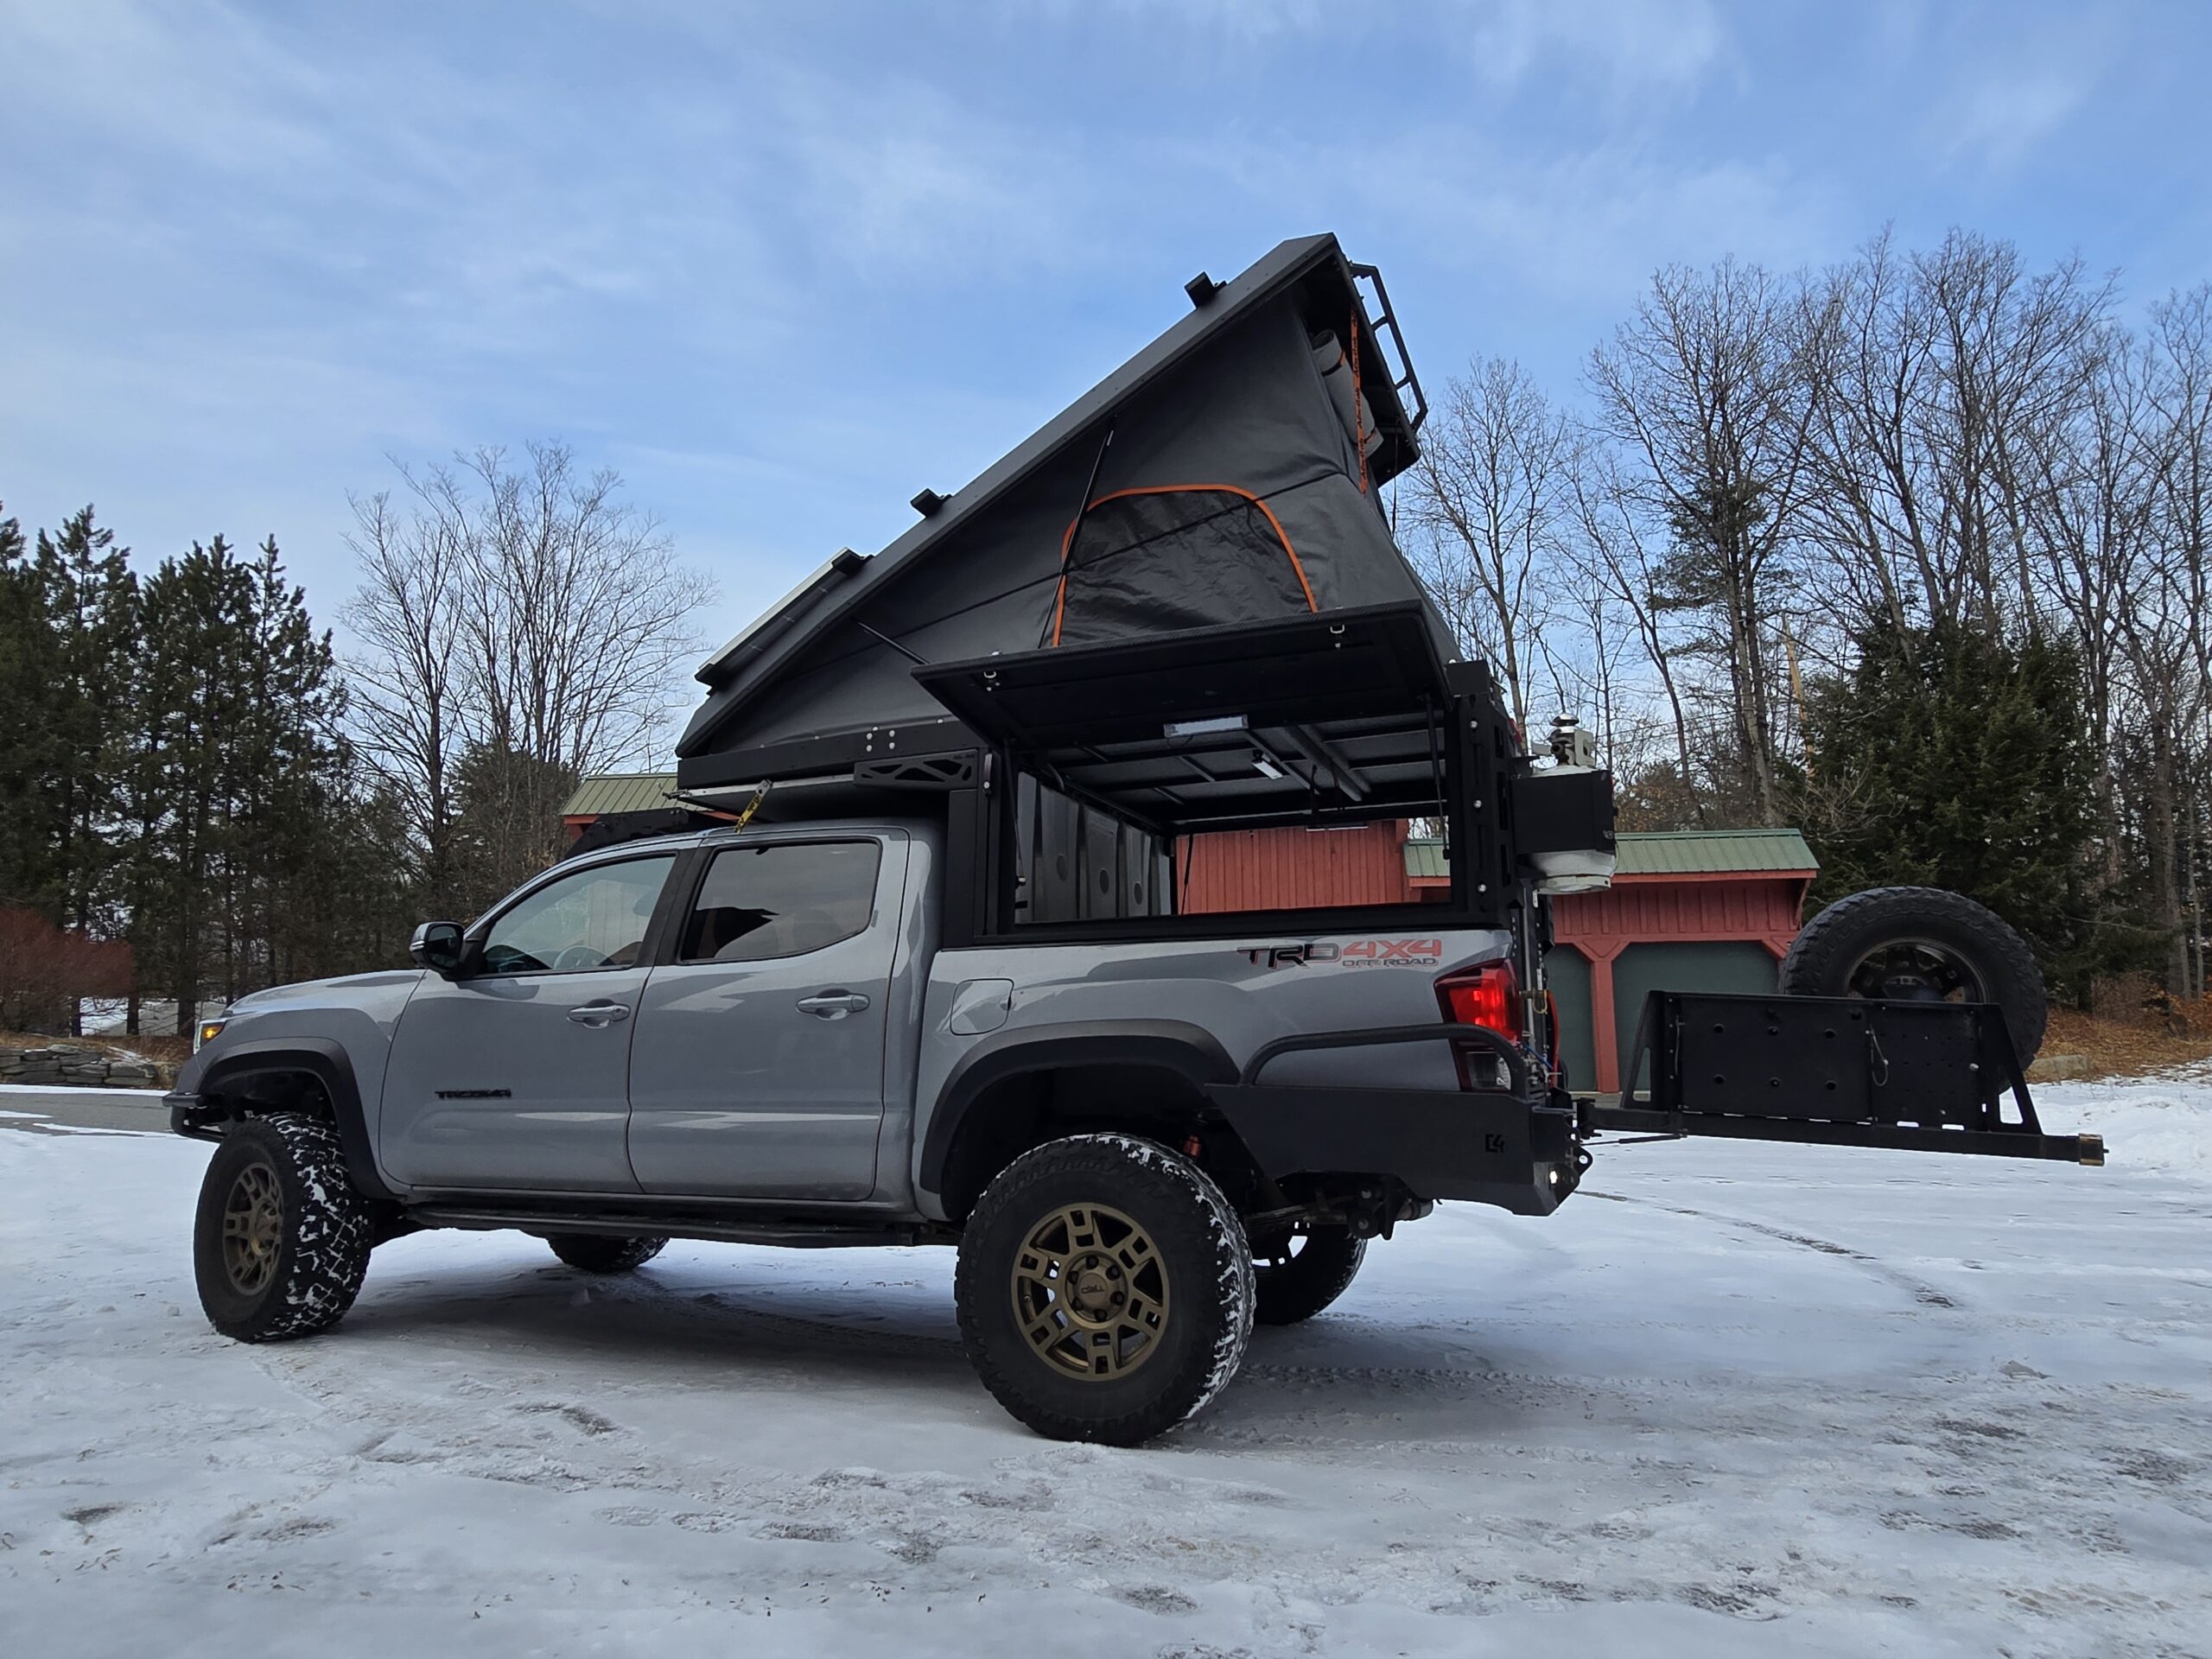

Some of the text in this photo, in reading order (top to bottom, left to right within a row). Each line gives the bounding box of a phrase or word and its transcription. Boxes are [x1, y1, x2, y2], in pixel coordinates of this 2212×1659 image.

[1236, 943, 1342, 969] TRD
[1382, 957, 1438, 967] ROAD
[434, 1089, 512, 1099] TACOMA
